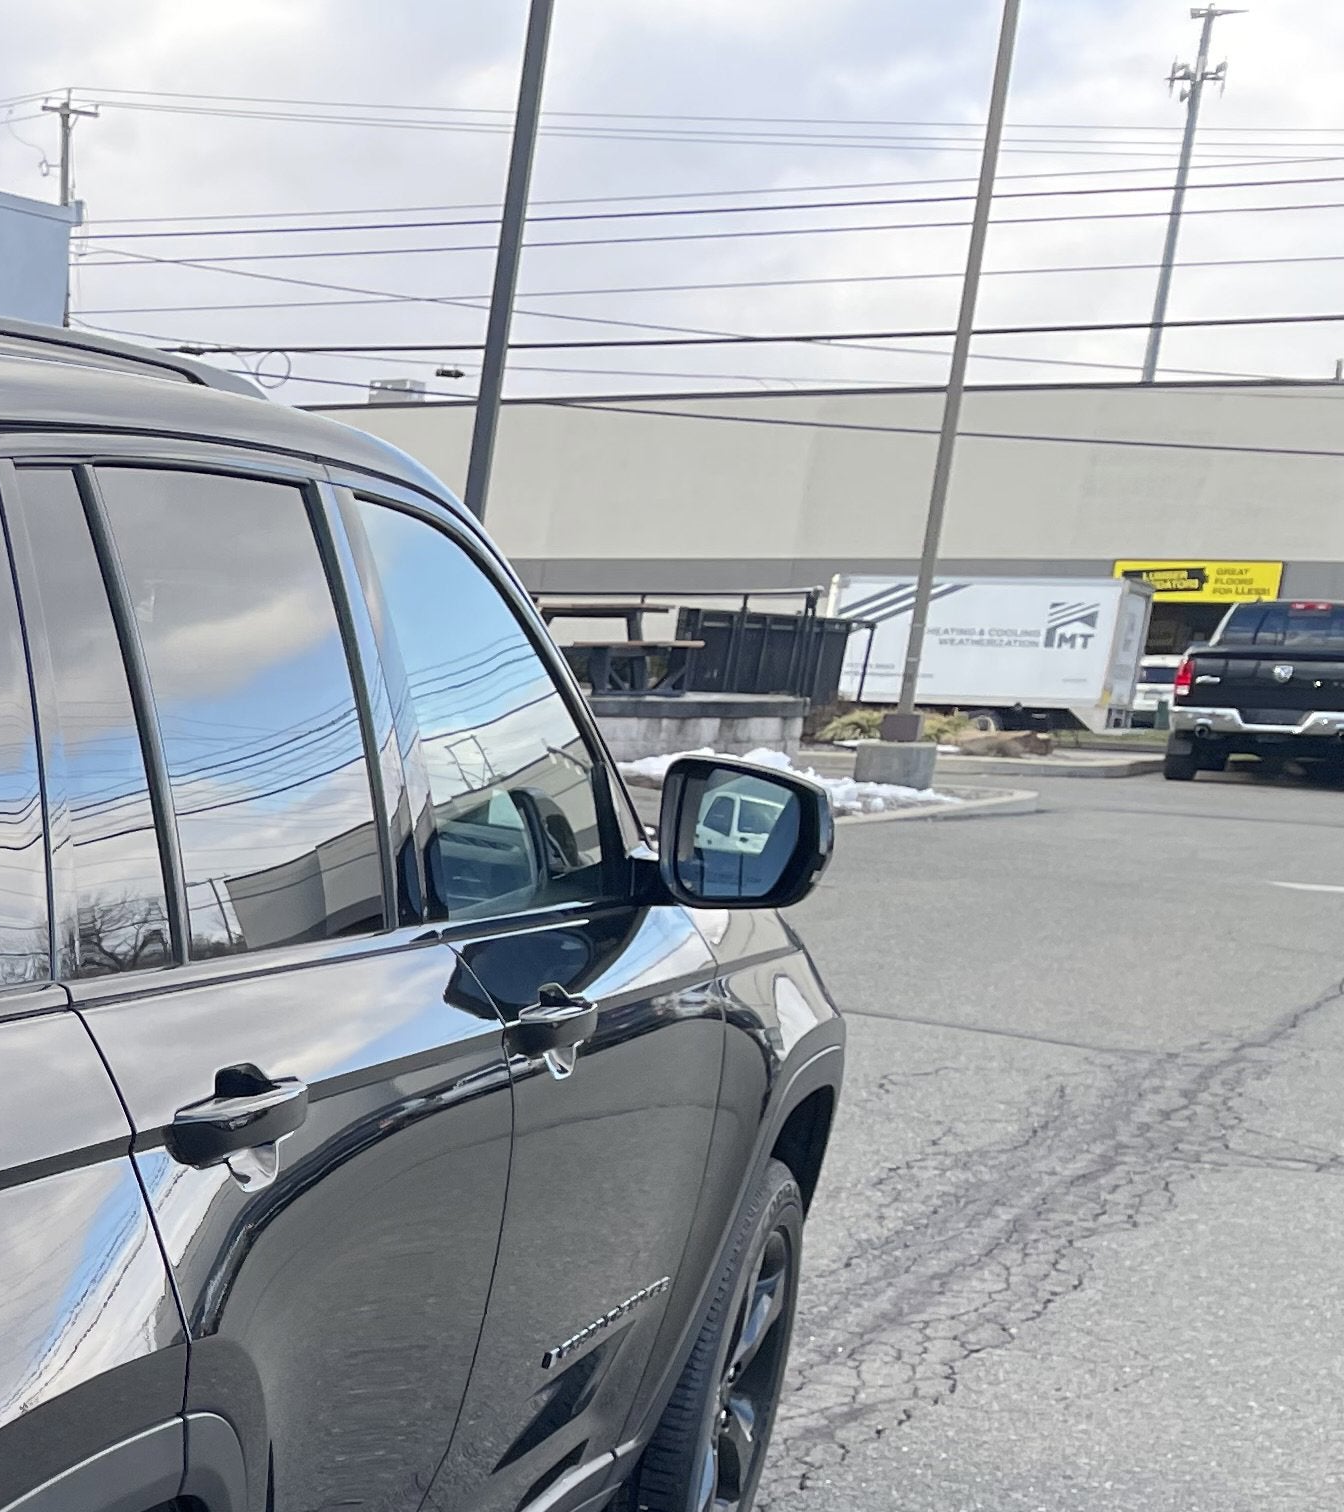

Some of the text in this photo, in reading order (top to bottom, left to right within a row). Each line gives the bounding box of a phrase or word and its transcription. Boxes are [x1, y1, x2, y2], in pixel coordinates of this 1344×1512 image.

[927, 627, 976, 637] HEATING
[987, 628, 1041, 638] COOLING
[938, 637, 1039, 648] WEATHERIZATION
